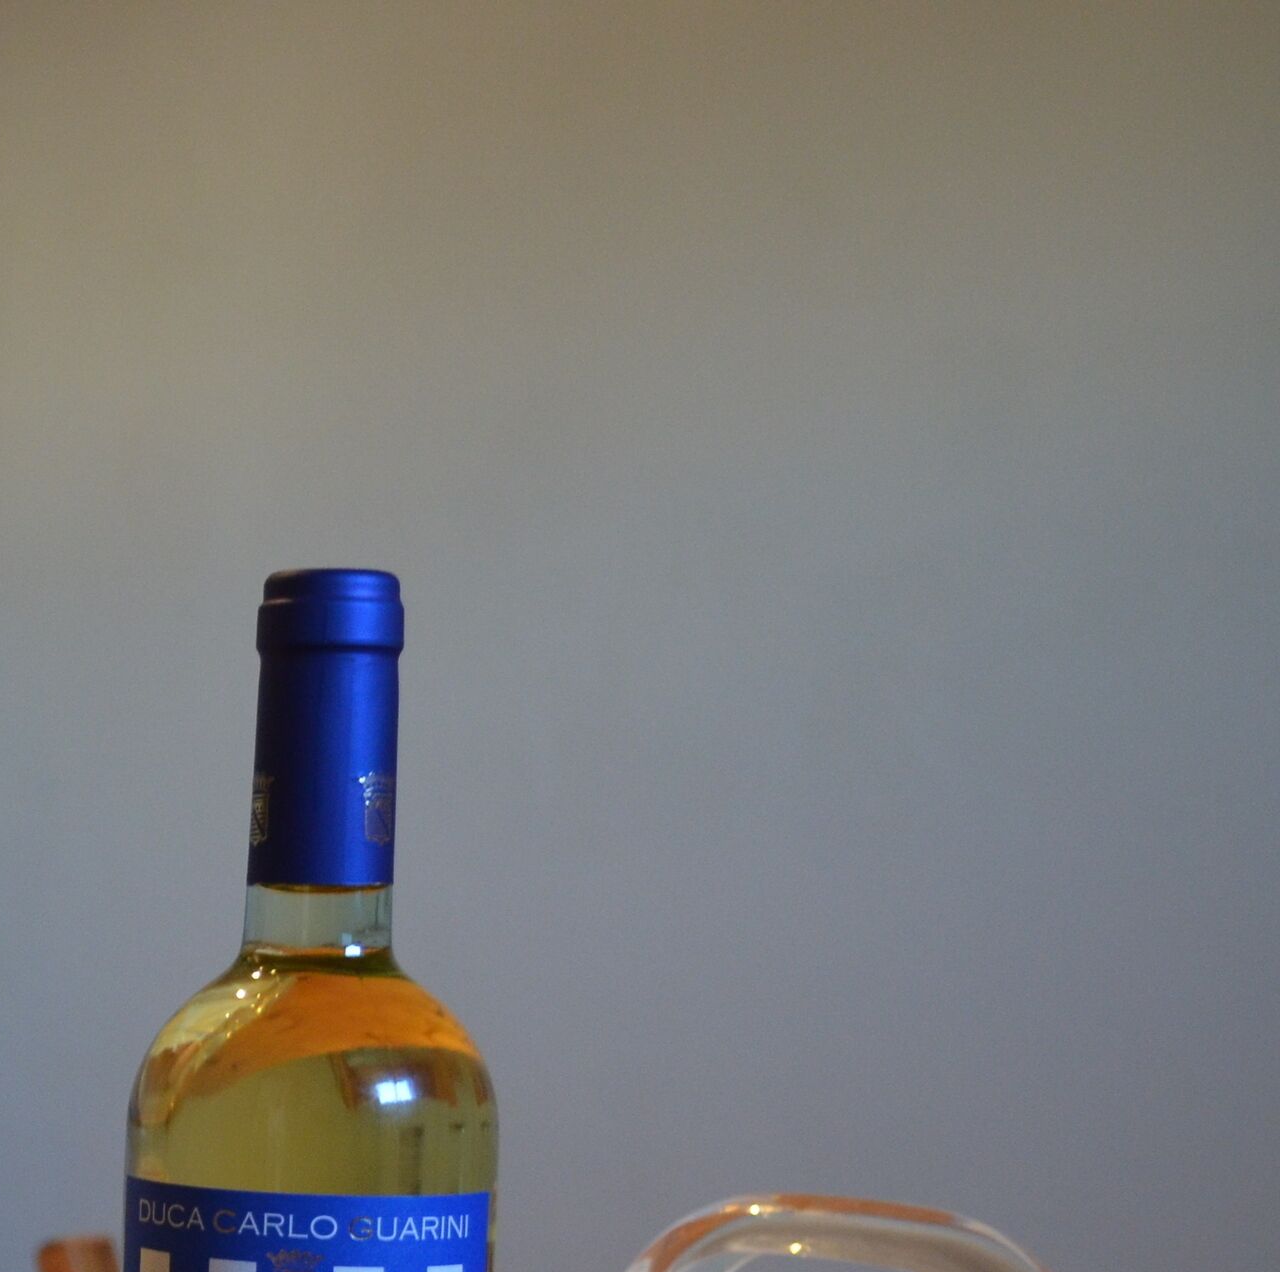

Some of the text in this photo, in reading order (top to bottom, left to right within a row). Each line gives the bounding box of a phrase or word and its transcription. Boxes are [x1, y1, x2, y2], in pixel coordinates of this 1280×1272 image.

[139, 1199, 468, 1241] DUCA CARLO GUARINI
